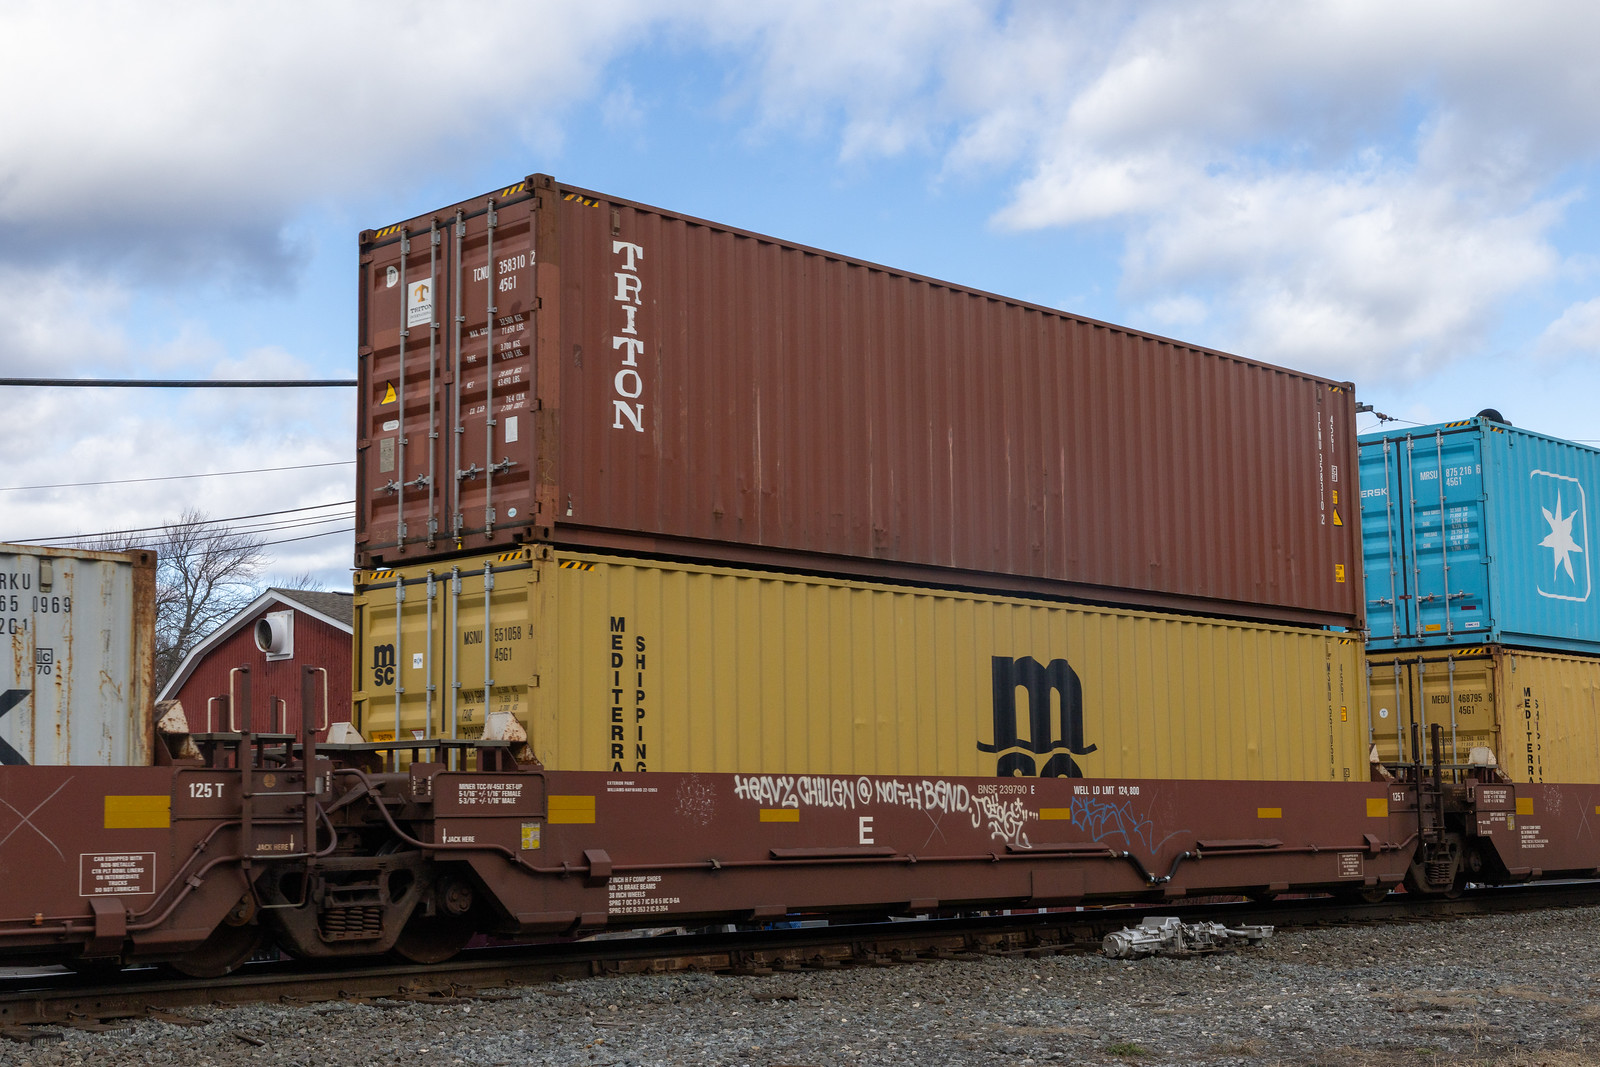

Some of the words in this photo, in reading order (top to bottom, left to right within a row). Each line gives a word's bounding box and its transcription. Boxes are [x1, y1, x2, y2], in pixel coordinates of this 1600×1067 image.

[473, 265, 489, 282] TCNU
[499, 254, 526, 275] 358310
[530, 250, 536, 266] 2
[499, 275, 517, 292] 45G1
[613, 240, 644, 432] TRITON
[1420, 470, 1438, 480] MRSU
[1445, 468, 1458, 477] 875
[1459, 466, 1472, 476] 216
[1476, 464, 1481, 474] 6
[1446, 477, 1462, 486] 45G1
[464, 630, 483, 645] MSNU
[494, 626, 522, 642] 551058
[494, 647, 512, 661] 45G1
[610, 616, 626, 772] MEDITERRA
[636, 636, 647, 772] SHIPPING
[1431, 695, 1449, 704] MEDU
[1458, 693, 1482, 703] 468795
[1488, 693, 1493, 703] 8
[1458, 705, 1475, 715] 45G1
[189, 783, 213, 798] 125
[215, 783, 225, 798] T
[977, 784, 997, 794] BNSF
[999, 784, 1027, 794] 239790
[1030, 785, 1035, 794] E
[1073, 785, 1089, 795] WELL
[1102, 785, 1115, 795] LMT
[1118, 786, 1140, 796] 124,800
[859, 816, 875, 844] E
[256, 843, 273, 851] JACK
